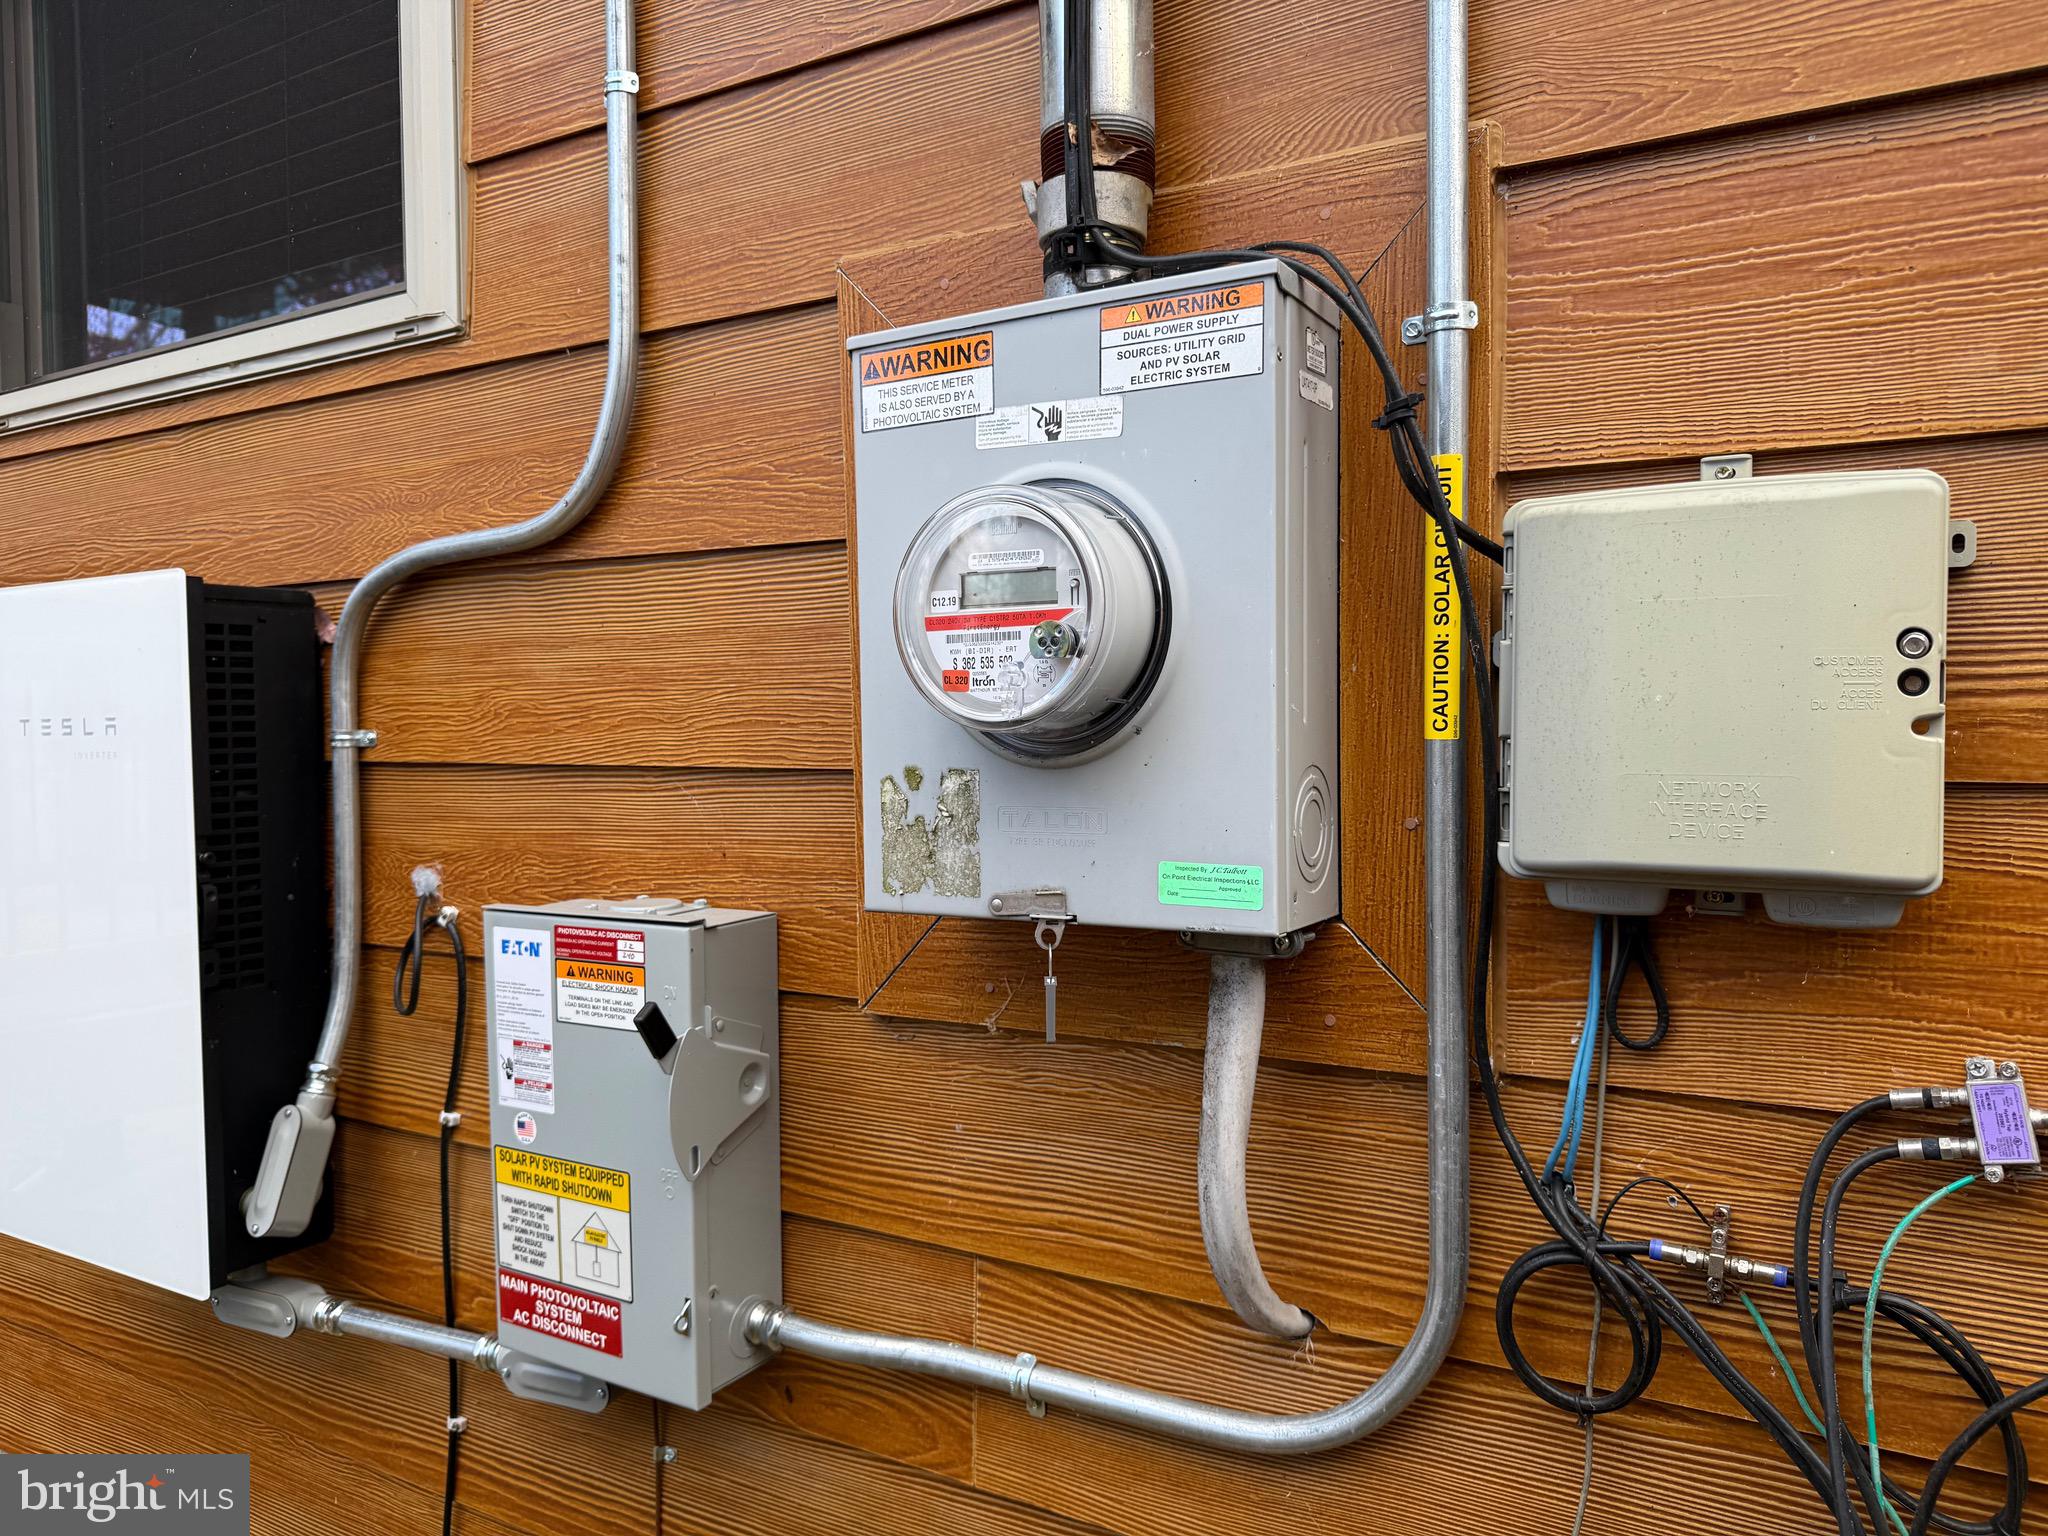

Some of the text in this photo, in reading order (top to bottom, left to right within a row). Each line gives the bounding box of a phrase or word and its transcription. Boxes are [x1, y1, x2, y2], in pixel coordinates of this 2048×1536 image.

[1145, 290, 1240, 319] WARNING
[1123, 314, 1239, 341] DUAL POWER SUPPLY
[1117, 333, 1246, 361] SOURCES: UTILITY GRID
[880, 340, 990, 377] WARNING
[1140, 351, 1220, 371] AND PV SOLAR
[1130, 363, 1231, 386] ELECTRIC SYSTEM
[878, 375, 974, 399] THIS SERVICE METER
[879, 390, 975, 413] IS ALSO SERVED BY A
[873, 409, 940, 427] PHOTOVOLTAIC
[943, 403, 981, 417] SYSTEM
[1433, 554, 1450, 626] SOLAR
[932, 597, 956, 607] C12.19
[953, 658, 958, 670] S
[962, 657, 975, 669] 362
[981, 656, 995, 669] 535
[1812, 656, 1884, 666] CUSTOMER
[944, 676, 968, 684] CL 320
[1832, 667, 1883, 678] ACCESS
[1432, 633, 1449, 733] CAUTION:
[1841, 689, 1882, 699] ACCES
[1810, 700, 1882, 711] DU CLIENT
[19, 717, 116, 736] TESLA
[1658, 781, 1760, 798] NETWORK
[1002, 808, 1102, 832] TALON
[1668, 823, 1745, 840] DEVICE
[558, 927, 597, 937] PHOTOVOLTAIC
[607, 932, 641, 941] DISCONNECT
[578, 966, 634, 983] WARNING
[562, 980, 593, 990] ELECTRICAL
[615, 986, 638, 995] HAZARD
[568, 994, 593, 1002] TERMINALS
[610, 1006, 636, 1015] ENERGIZED
[499, 1149, 624, 1187] SOLAR PV SYSTEM EQUIPPED
[512, 1168, 613, 1203] WITH RAPID SHUTDOWN
[501, 1195, 554, 1214] TURN RAPID SHUTDOWN
[511, 1206, 545, 1220] SWITCH TO THE
[502, 1222, 554, 1242] SHUT DOWN PV SYSTEM
[521, 1218, 542, 1229] POSITION
[543, 1223, 549, 1231] TO
[512, 1243, 547, 1258] SHOCK HAZARD
[514, 1235, 543, 1248] AND REDUCE
[520, 1255, 528, 1263] THE
[529, 1257, 545, 1267] ARRAY
[500, 1274, 619, 1321] MAIN PHOTOVOLTAIC
[535, 1300, 582, 1325] SYSTEM
[514, 1309, 607, 1348] AC DISCONNECT
